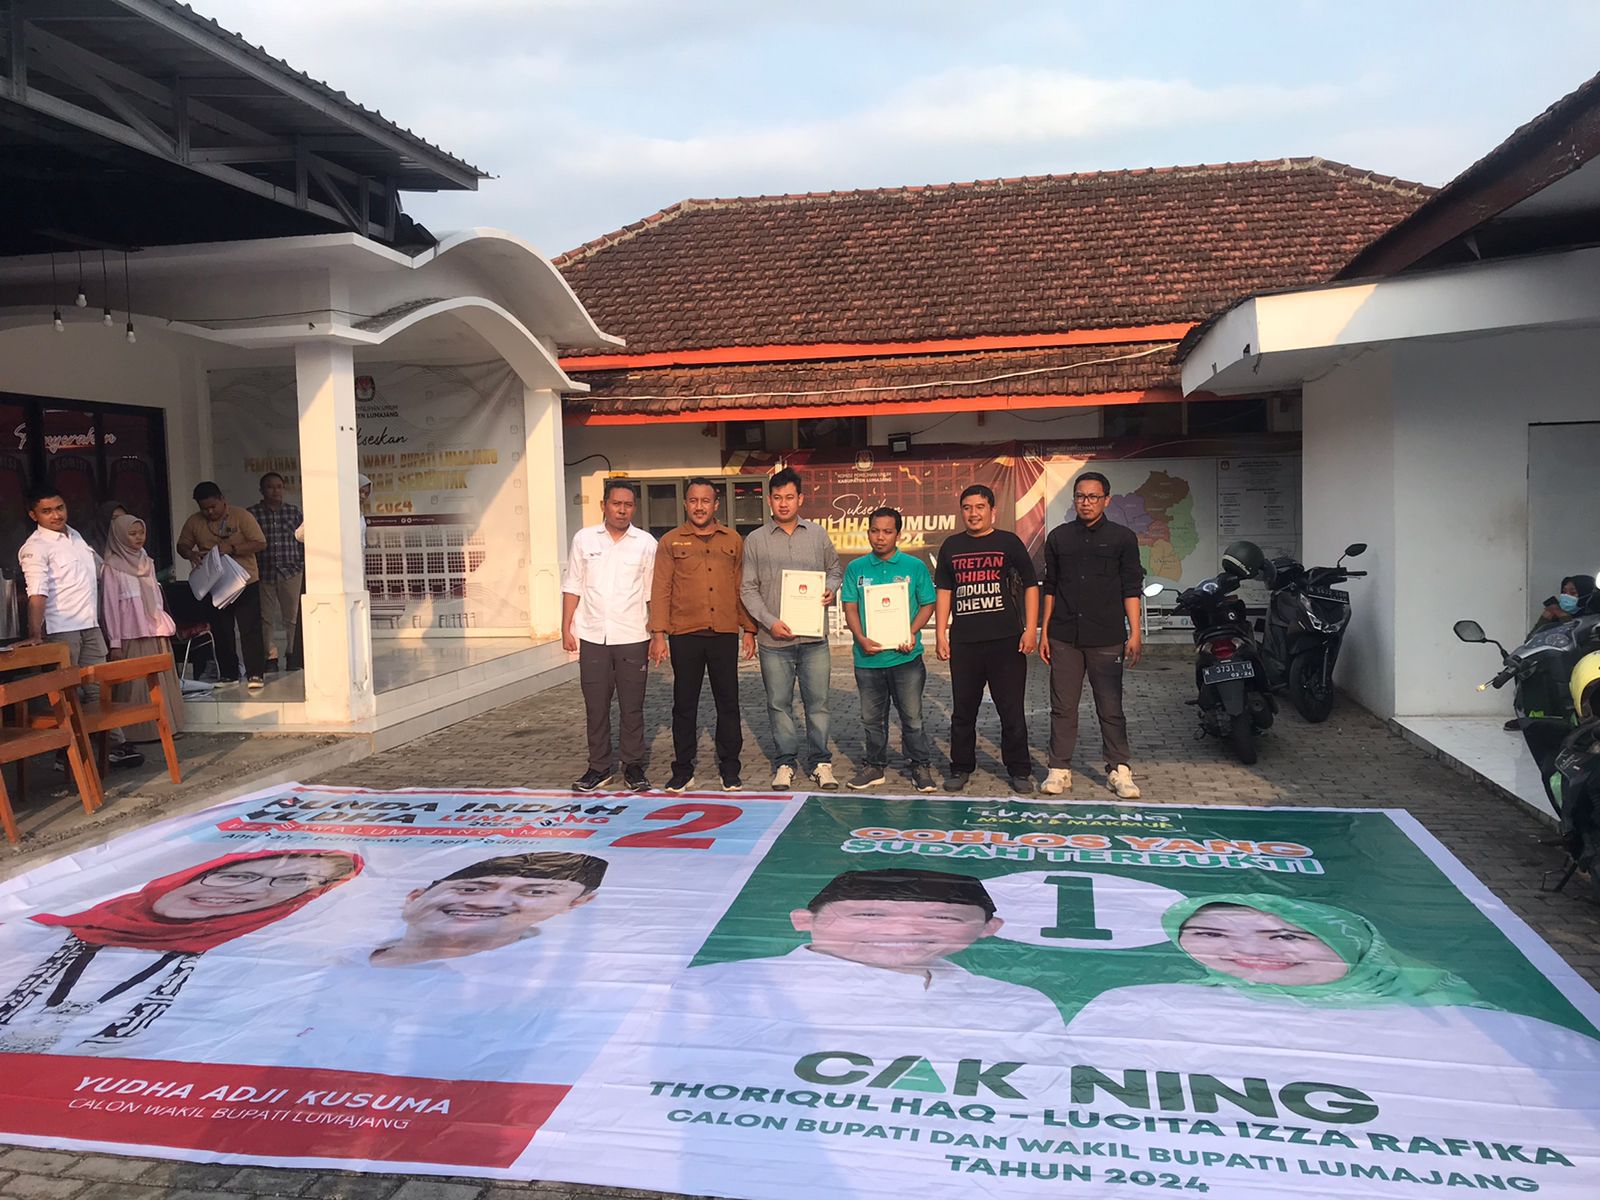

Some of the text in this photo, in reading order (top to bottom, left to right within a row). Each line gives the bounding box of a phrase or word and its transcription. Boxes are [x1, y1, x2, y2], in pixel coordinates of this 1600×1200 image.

[357, 426, 408, 446] kseskan
[803, 514, 956, 534] MILIHA UMUM
[828, 533, 871, 549] HUN
[952, 557, 1004, 570] TRETAN
[956, 596, 1003, 612] DHEWE
[967, 583, 1001, 596] DULUR
[608, 802, 744, 849] 2
[977, 817, 1043, 825] MAJU
[981, 808, 1171, 822] LUMAJANG
[841, 838, 1325, 875] SUDAH TERBUKTI
[850, 827, 1314, 857] COBLOS YANG
[1040, 876, 1113, 940] 1
[73, 1076, 453, 1115] YUDHA ADJI KUSUMA
[794, 1050, 1380, 1125] CAK NING
[69, 1097, 412, 1131] CALON WAKIL BUPATI LUMAJANG
[649, 1080, 879, 1114] THORIQUL
[890, 1096, 997, 1125] HAQ
[1044, 1110, 1227, 1137] LUCITA
[1238, 1121, 1359, 1149] IZZA
[1366, 1132, 1577, 1168] RAFIKA
[667, 1109, 1540, 1193] CALON BUPATI DAN WAKIL BUPATI LUMAJANG
[945, 1154, 1210, 1193] TAHUN 2024
